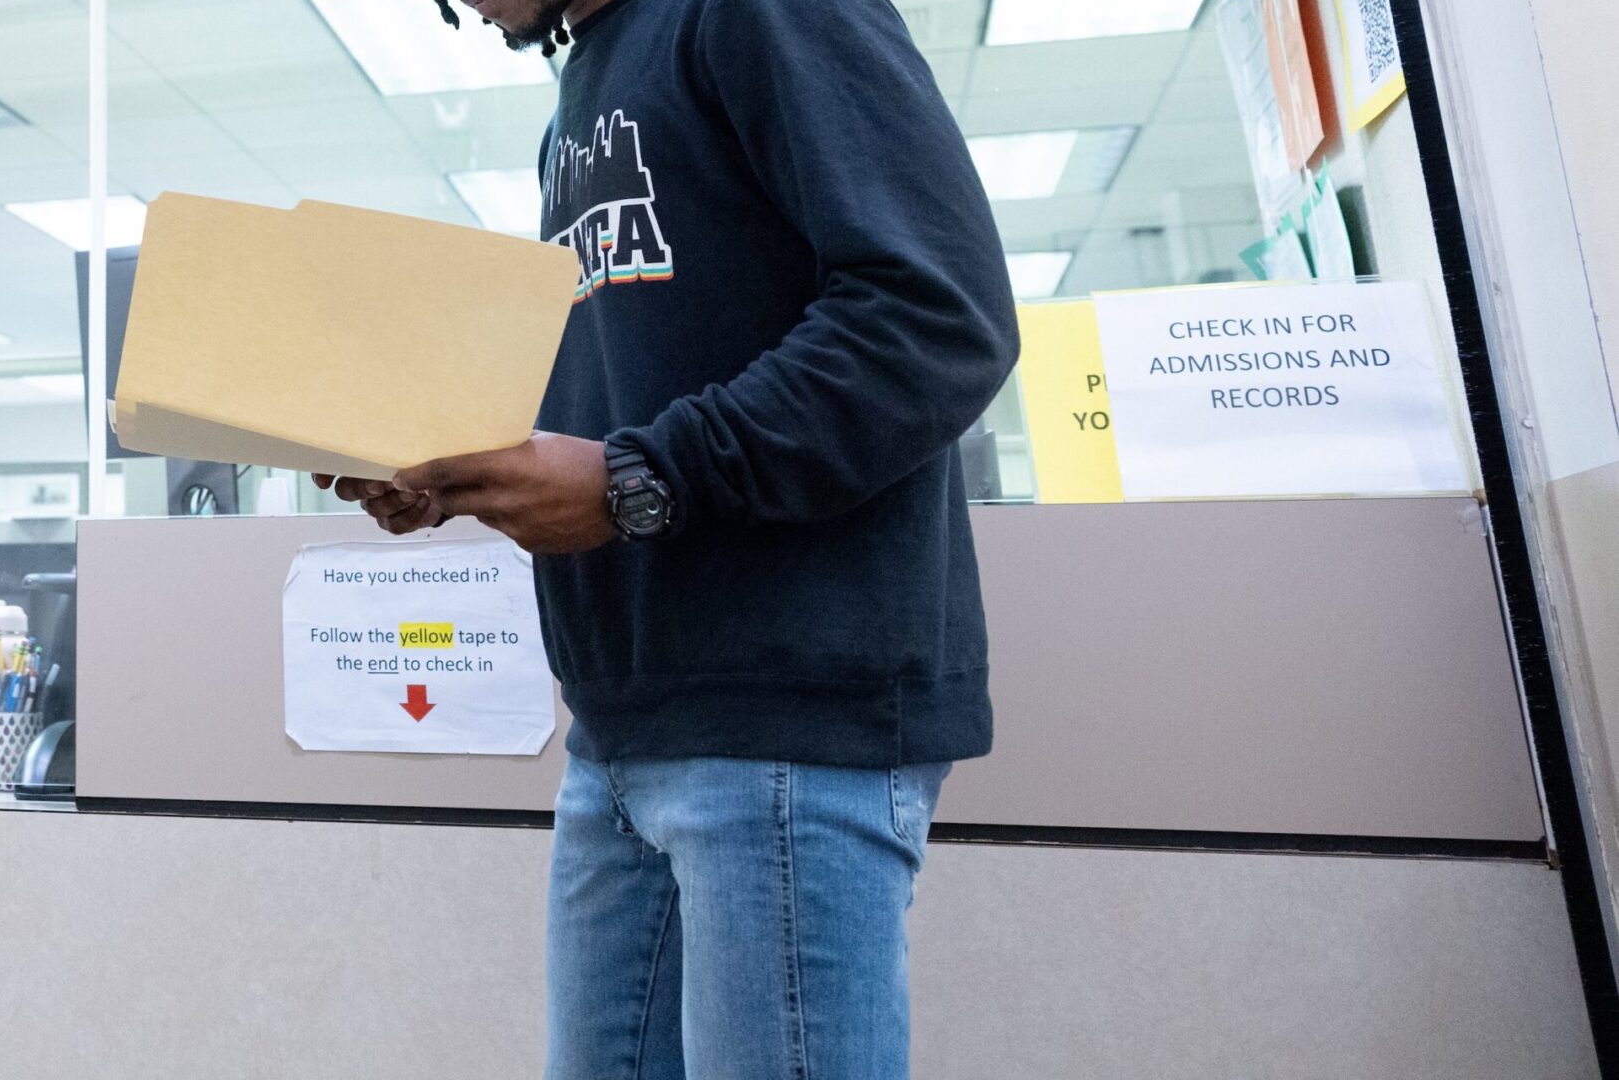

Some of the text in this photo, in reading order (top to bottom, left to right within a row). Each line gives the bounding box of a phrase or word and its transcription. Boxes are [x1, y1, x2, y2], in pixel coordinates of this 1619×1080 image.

[554, 198, 673, 290] NTA
[1168, 314, 1357, 340] CHECK IN FOR
[1149, 348, 1391, 375] ADMISSIONS AND
[1210, 385, 1340, 409] RECORDS
[324, 566, 500, 587] Have you checked in?
[310, 627, 519, 647] Follow the yellow tape to
[335, 654, 493, 674] the end to check in
